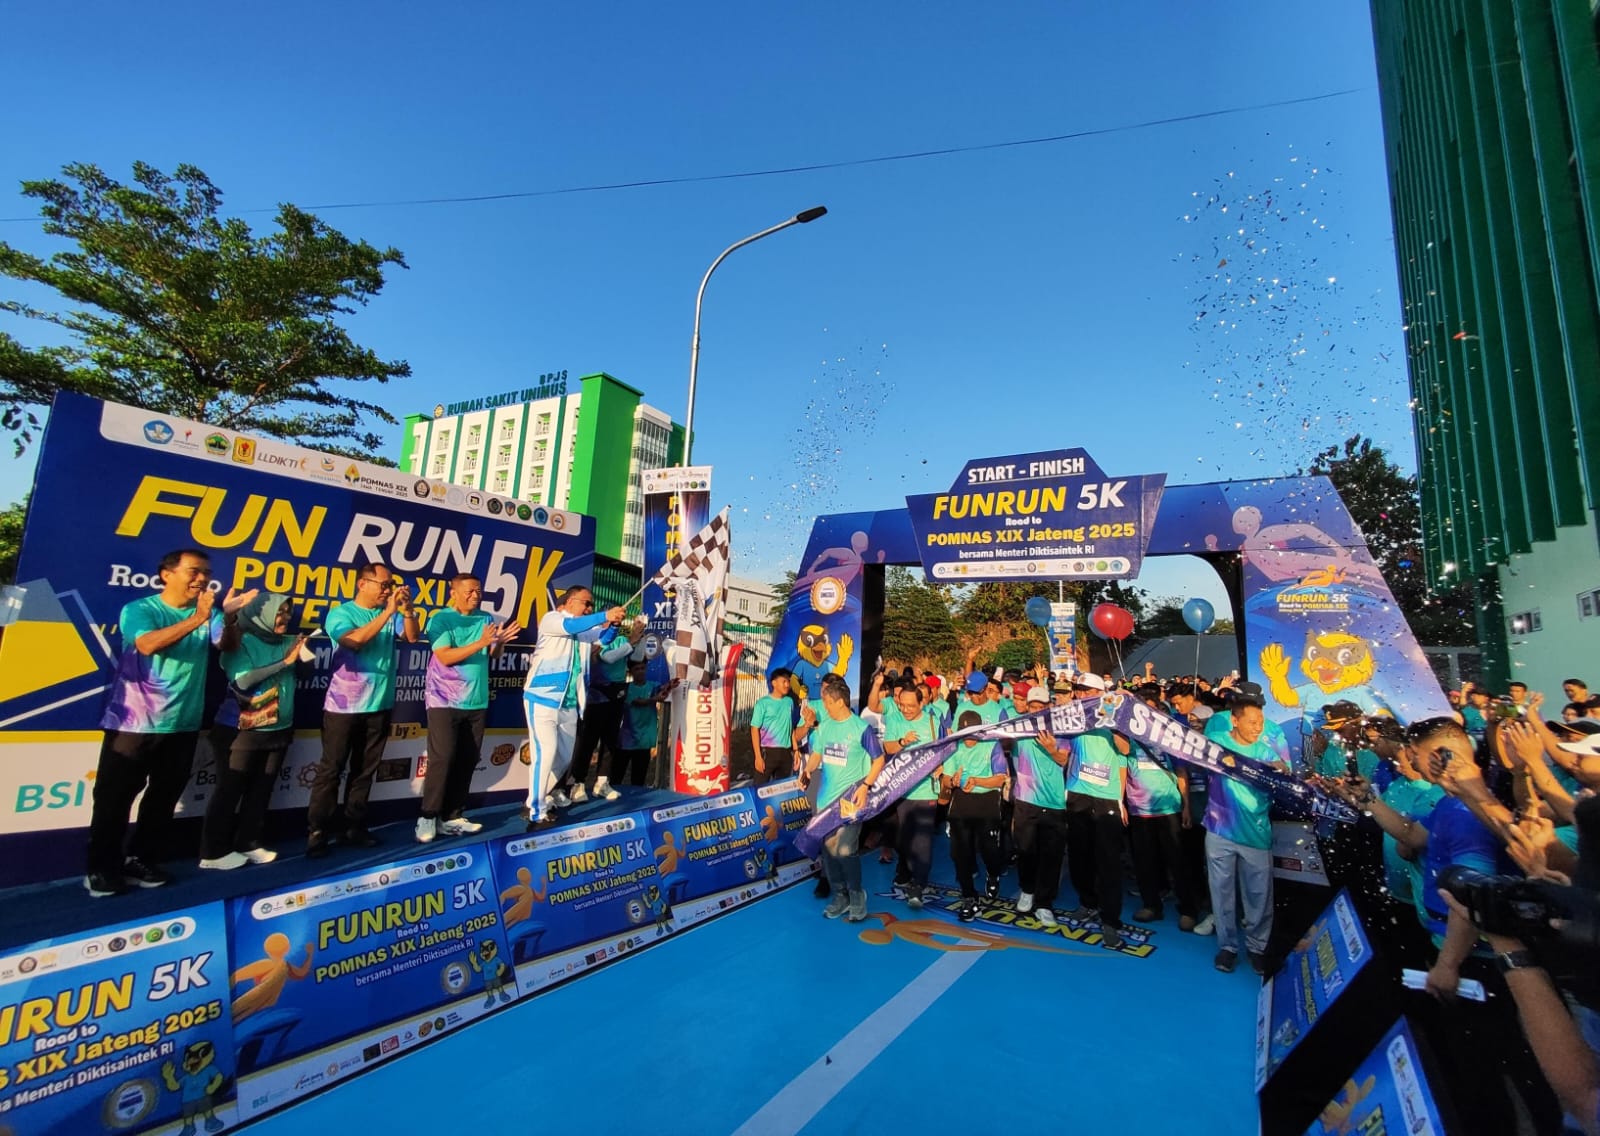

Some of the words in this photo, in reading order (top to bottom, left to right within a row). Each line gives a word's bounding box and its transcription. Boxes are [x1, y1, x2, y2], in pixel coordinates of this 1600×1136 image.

[539, 369, 568, 386] BPJS
[447, 399, 484, 417] RUMAH
[485, 391, 518, 409] SAKIT
[520, 382, 567, 403] UNIMUS
[968, 464, 1016, 483] START
[1029, 457, 1084, 477] FINISH
[932, 486, 1068, 521] FUNRUN
[1076, 481, 1128, 511] 5K
[927, 530, 992, 546] POMNAS
[995, 529, 1024, 543] XIX
[1026, 524, 1086, 543] Jateng
[1088, 523, 1135, 539] 2025
[1005, 515, 1029, 526] Road
[1031, 515, 1041, 525] to
[115, 475, 328, 559] FUN
[338, 513, 482, 575] RUN
[481, 540, 564, 629] 5K
[959, 548, 994, 560] bersama
[995, 546, 1028, 558] Menteri
[1029, 544, 1083, 557] Diktisaintek
[1085, 544, 1095, 555] RI
[414, 577, 456, 608] XI
[1277, 593, 1329, 603] FUNRUN
[1331, 593, 1349, 602] 5K
[696, 717, 712, 733] IN
[1129, 703, 1224, 766] START
[695, 734, 712, 765] HOT
[888, 764, 918, 792] TENGAH
[15, 780, 86, 812] BSI
[684, 814, 737, 844] FUNRUN
[739, 811, 756, 829] 5K
[547, 845, 622, 882] FUNRUN
[626, 839, 648, 860] 5K
[688, 847, 717, 862] POMNAS
[549, 885, 590, 907] POMNAS
[591, 880, 608, 892] XIX
[609, 873, 637, 889] Jateng
[637, 865, 657, 880] 2025
[319, 890, 445, 950] FUNRUN
[453, 879, 486, 909] 5K
[397, 924, 418, 939] Road
[420, 921, 430, 931] to
[316, 948, 387, 984] POMNAS
[390, 940, 416, 958] XIX
[419, 924, 465, 949] Jateng
[466, 912, 497, 931] 2025
[354, 968, 392, 988] bersama
[393, 955, 422, 975] Menteri
[423, 942, 465, 963] Diktisaintek
[465, 938, 474, 948] RI
[148, 951, 213, 1001] 5K
[16, 1049, 68, 1084] XIX
[73, 1021, 161, 1066] Jateng
[164, 1002, 222, 1034] 2025
[34, 1028, 78, 1052] Road
[81, 1024, 99, 1038] to
[15, 1077, 76, 1109] Menteri
[77, 1050, 159, 1085] Diktisaintek
[160, 1041, 175, 1057] RI
